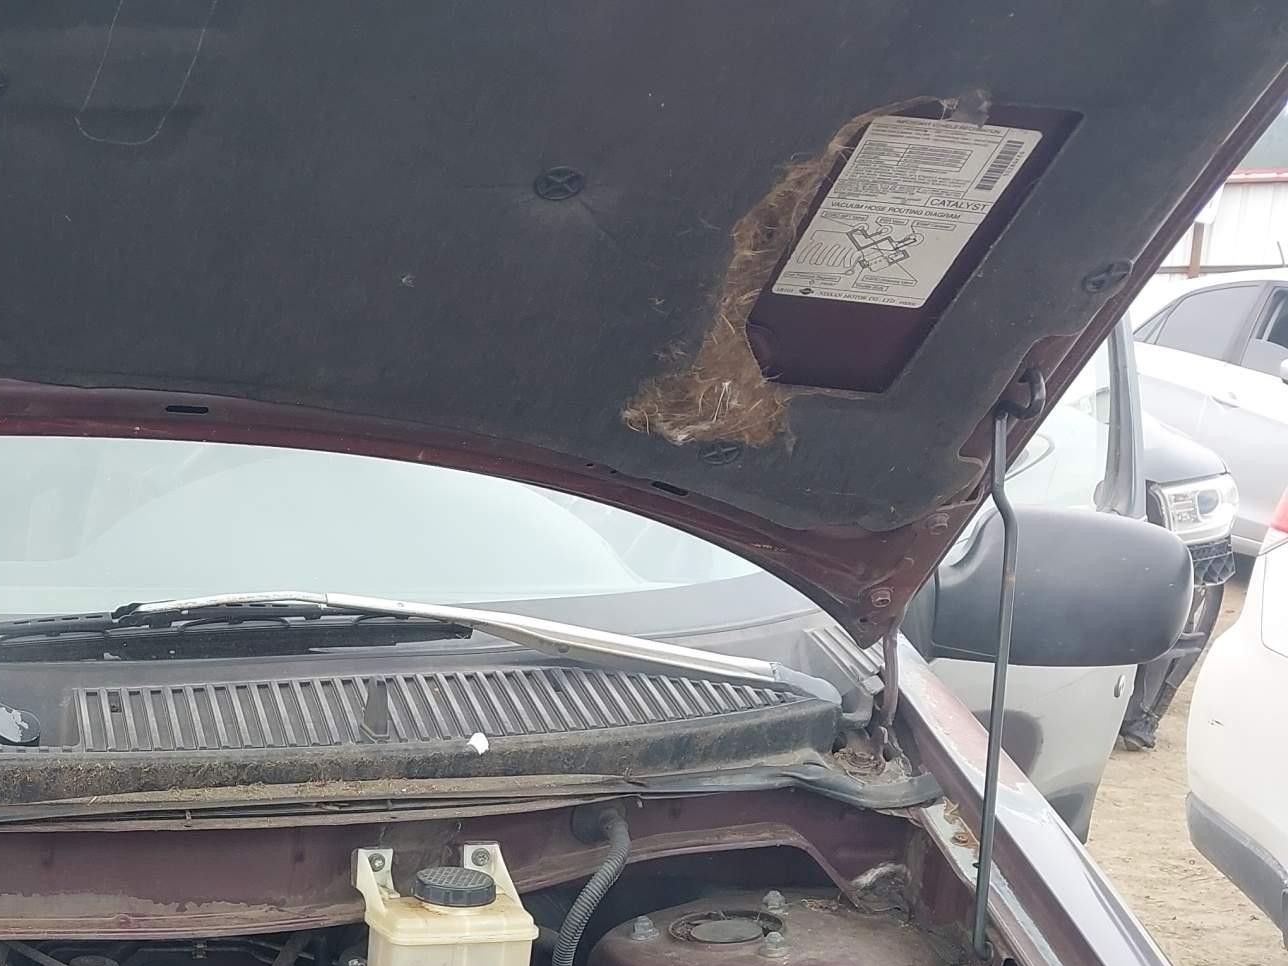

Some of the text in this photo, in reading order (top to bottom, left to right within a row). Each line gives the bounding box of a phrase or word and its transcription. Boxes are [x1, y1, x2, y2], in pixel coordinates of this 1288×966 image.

[830, 201, 961, 219] VACUUM HOSE ROUTING DIAGRAM
[929, 197, 987, 212] CATALYST
